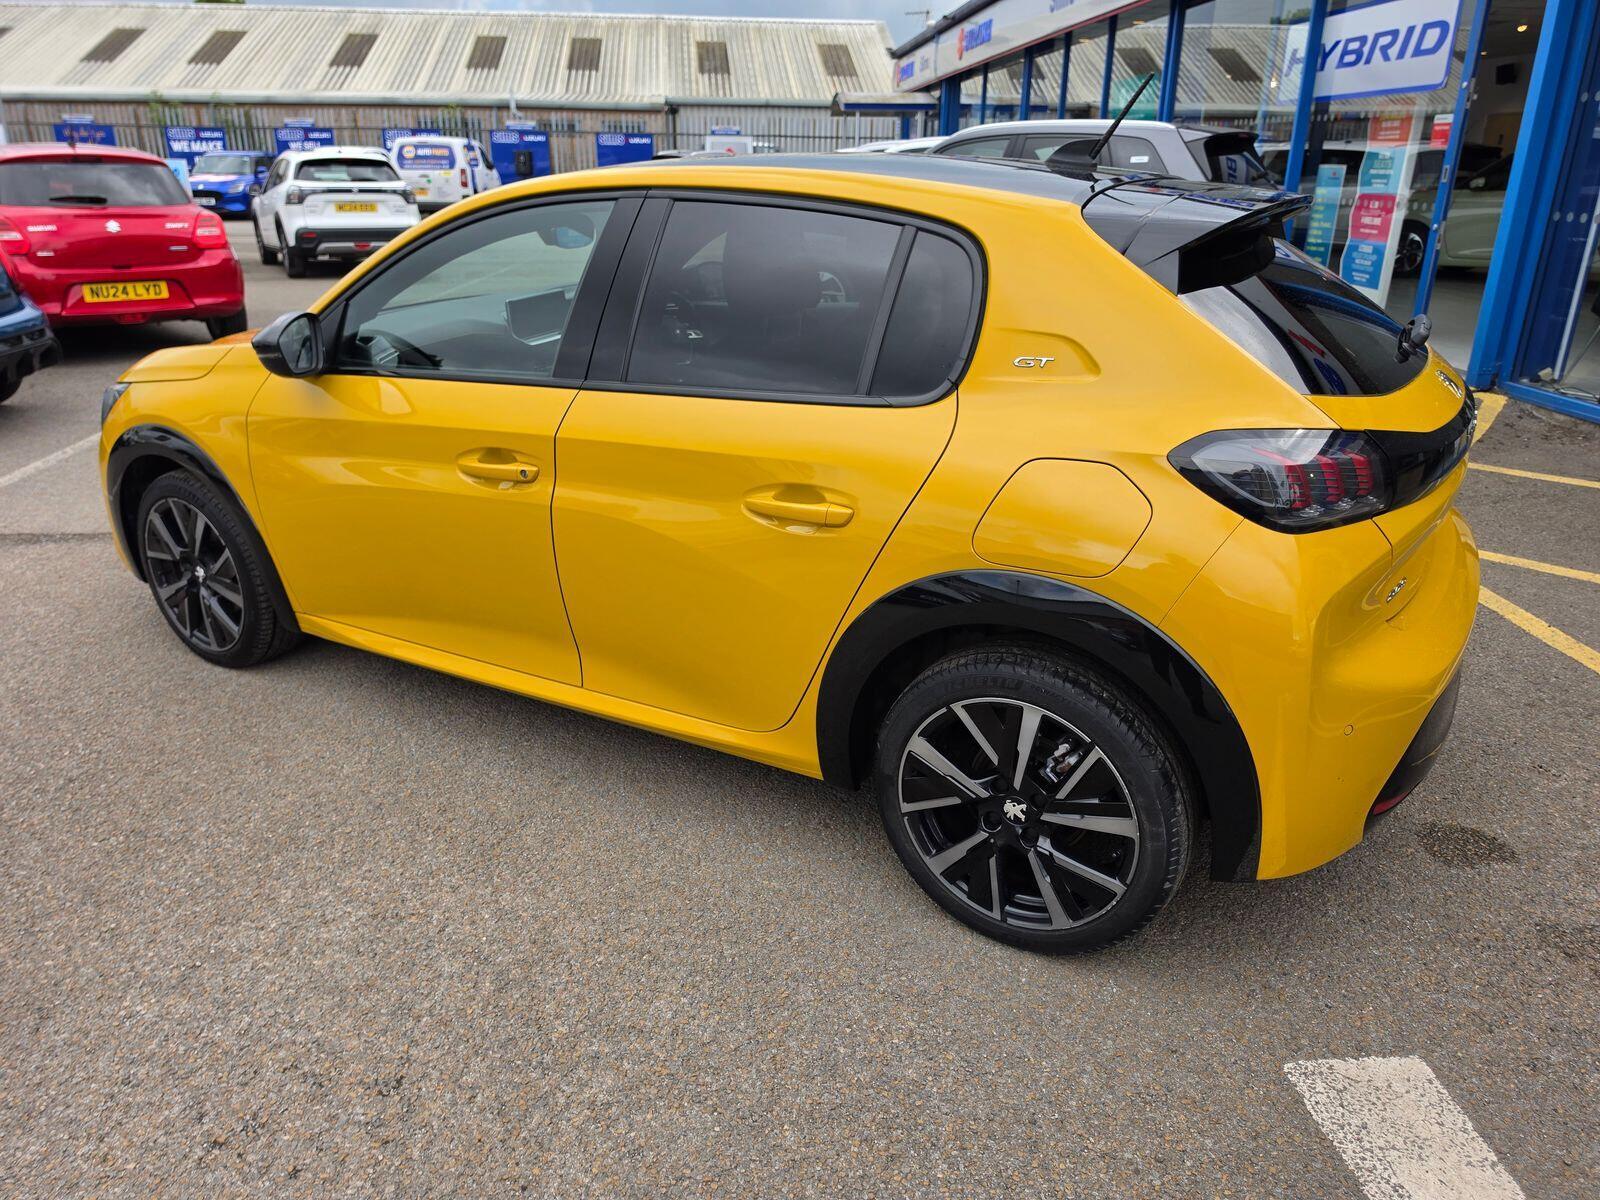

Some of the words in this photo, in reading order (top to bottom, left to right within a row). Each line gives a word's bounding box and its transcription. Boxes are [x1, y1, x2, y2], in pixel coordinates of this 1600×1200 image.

[89, 285, 129, 299] NU24
[134, 284, 163, 298] LYD
[1012, 356, 1055, 368] GT
